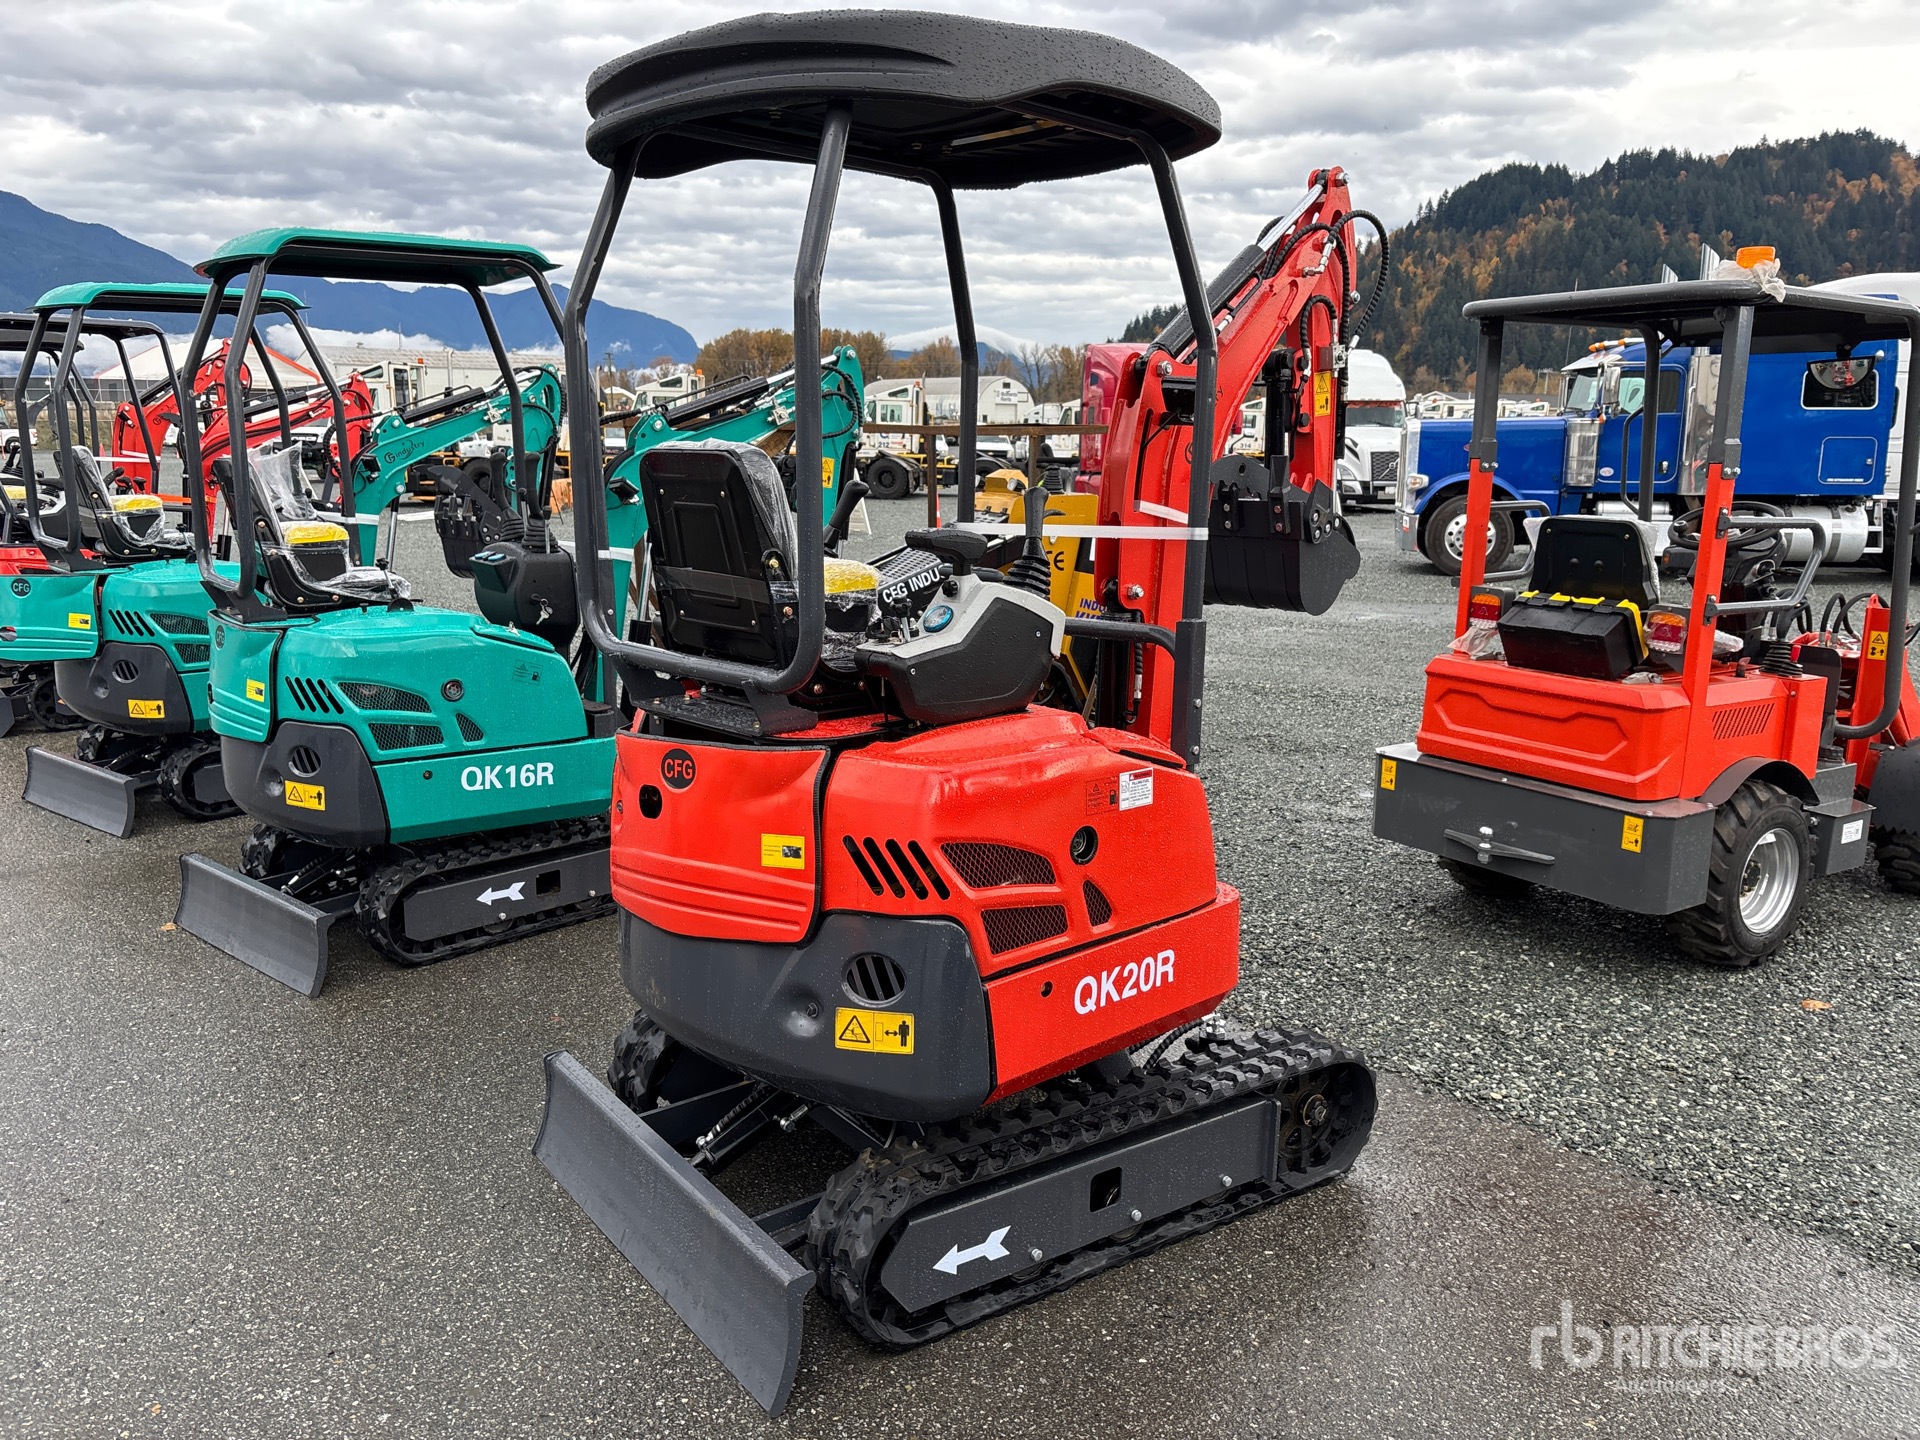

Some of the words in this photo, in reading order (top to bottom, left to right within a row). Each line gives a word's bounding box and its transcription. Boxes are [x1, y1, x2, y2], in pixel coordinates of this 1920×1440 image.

[12, 582, 30, 593] CFG
[460, 761, 555, 791] QK16R
[664, 758, 693, 780] CFG
[1073, 948, 1176, 1015] QK20R
